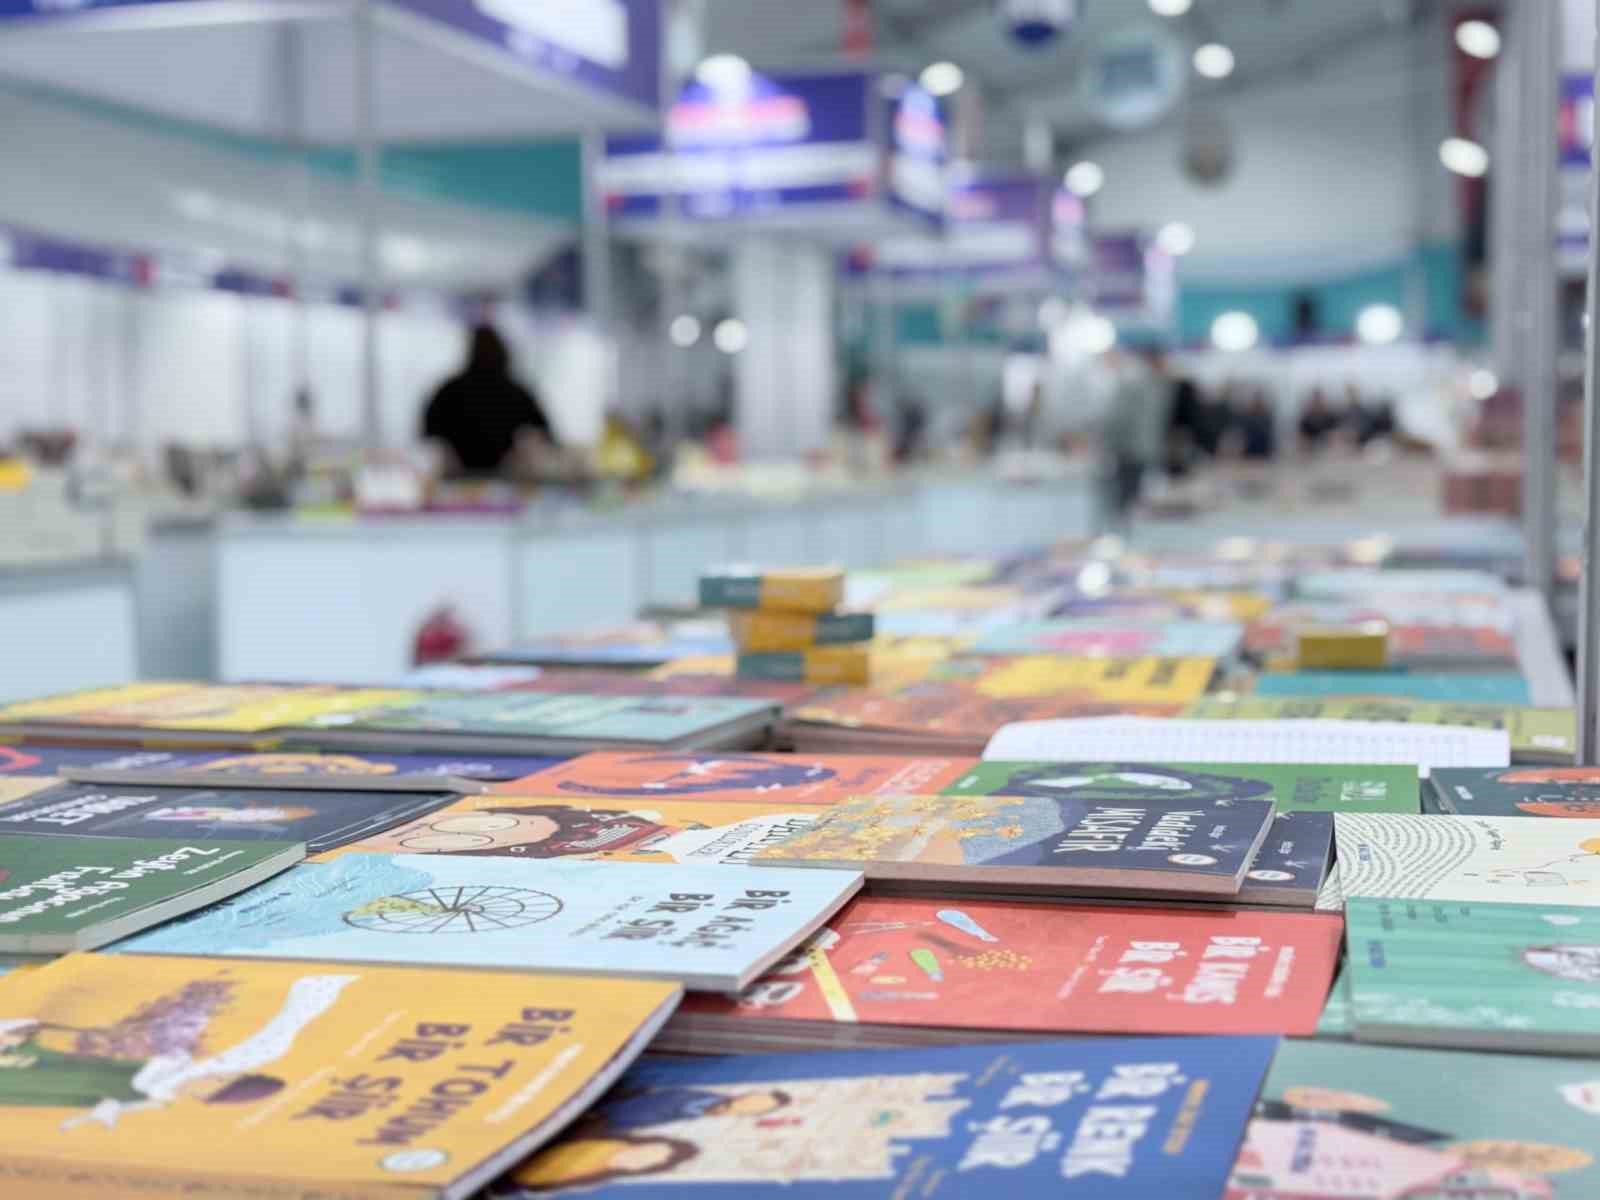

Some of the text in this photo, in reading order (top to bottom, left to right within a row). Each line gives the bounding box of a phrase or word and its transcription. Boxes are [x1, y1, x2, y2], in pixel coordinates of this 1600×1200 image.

[1053, 807, 1147, 853] MİSAFİR
[1126, 810, 1206, 852] Vadideki
[643, 893, 716, 914] BİR
[723, 889, 792, 910] BİR
[1118, 941, 1188, 963] BİR
[1202, 936, 1270, 960] BİR
[376, 1022, 473, 1062] BİR
[484, 1007, 576, 1047] BİR
[1000, 1071, 1091, 1109] BİR
[1094, 1062, 1187, 1100] BİR
[356, 1060, 517, 1146] TOHUM
